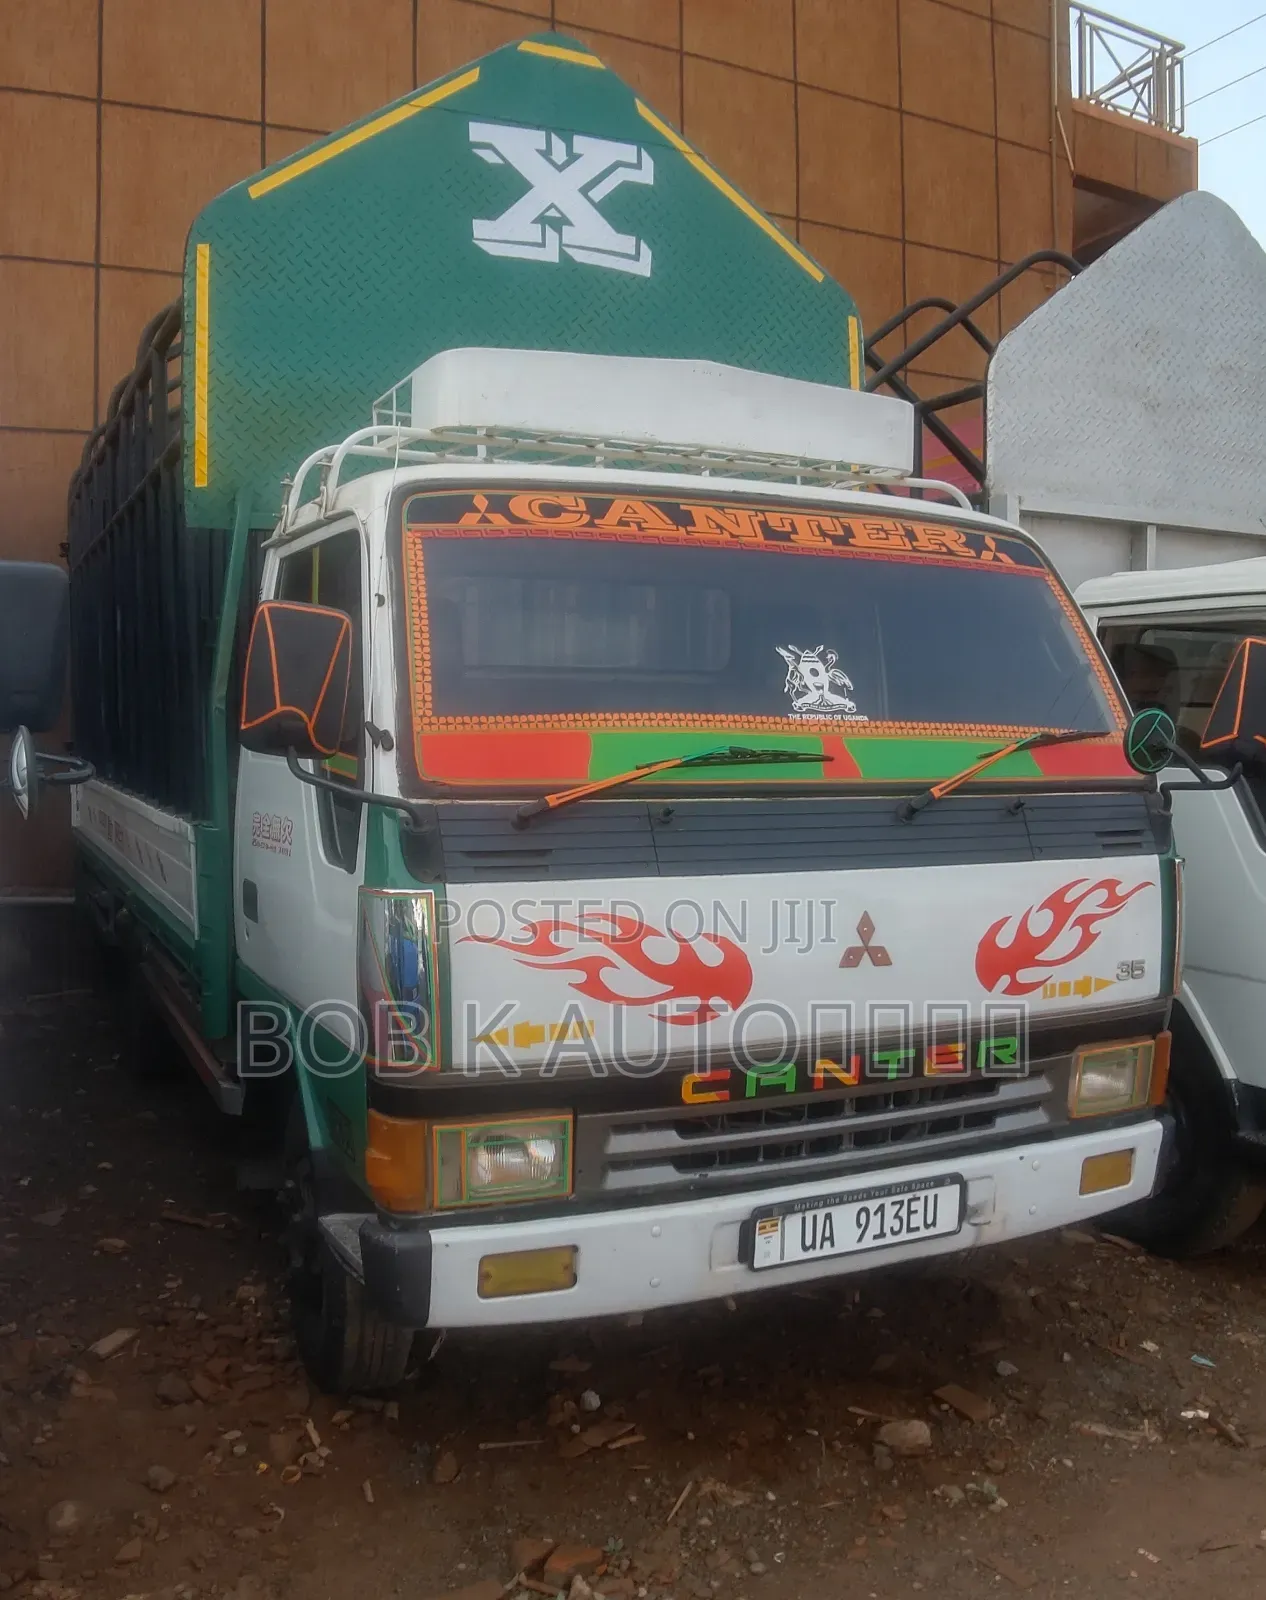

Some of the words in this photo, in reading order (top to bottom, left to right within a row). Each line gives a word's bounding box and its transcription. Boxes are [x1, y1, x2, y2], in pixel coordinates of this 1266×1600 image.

[468, 121, 654, 278] X
[508, 494, 977, 556] CANTER
[1116, 959, 1146, 981] 35
[681, 1036, 1021, 1105] CANTER
[800, 1212, 835, 1252] UA
[856, 1193, 939, 1243] 913EU
